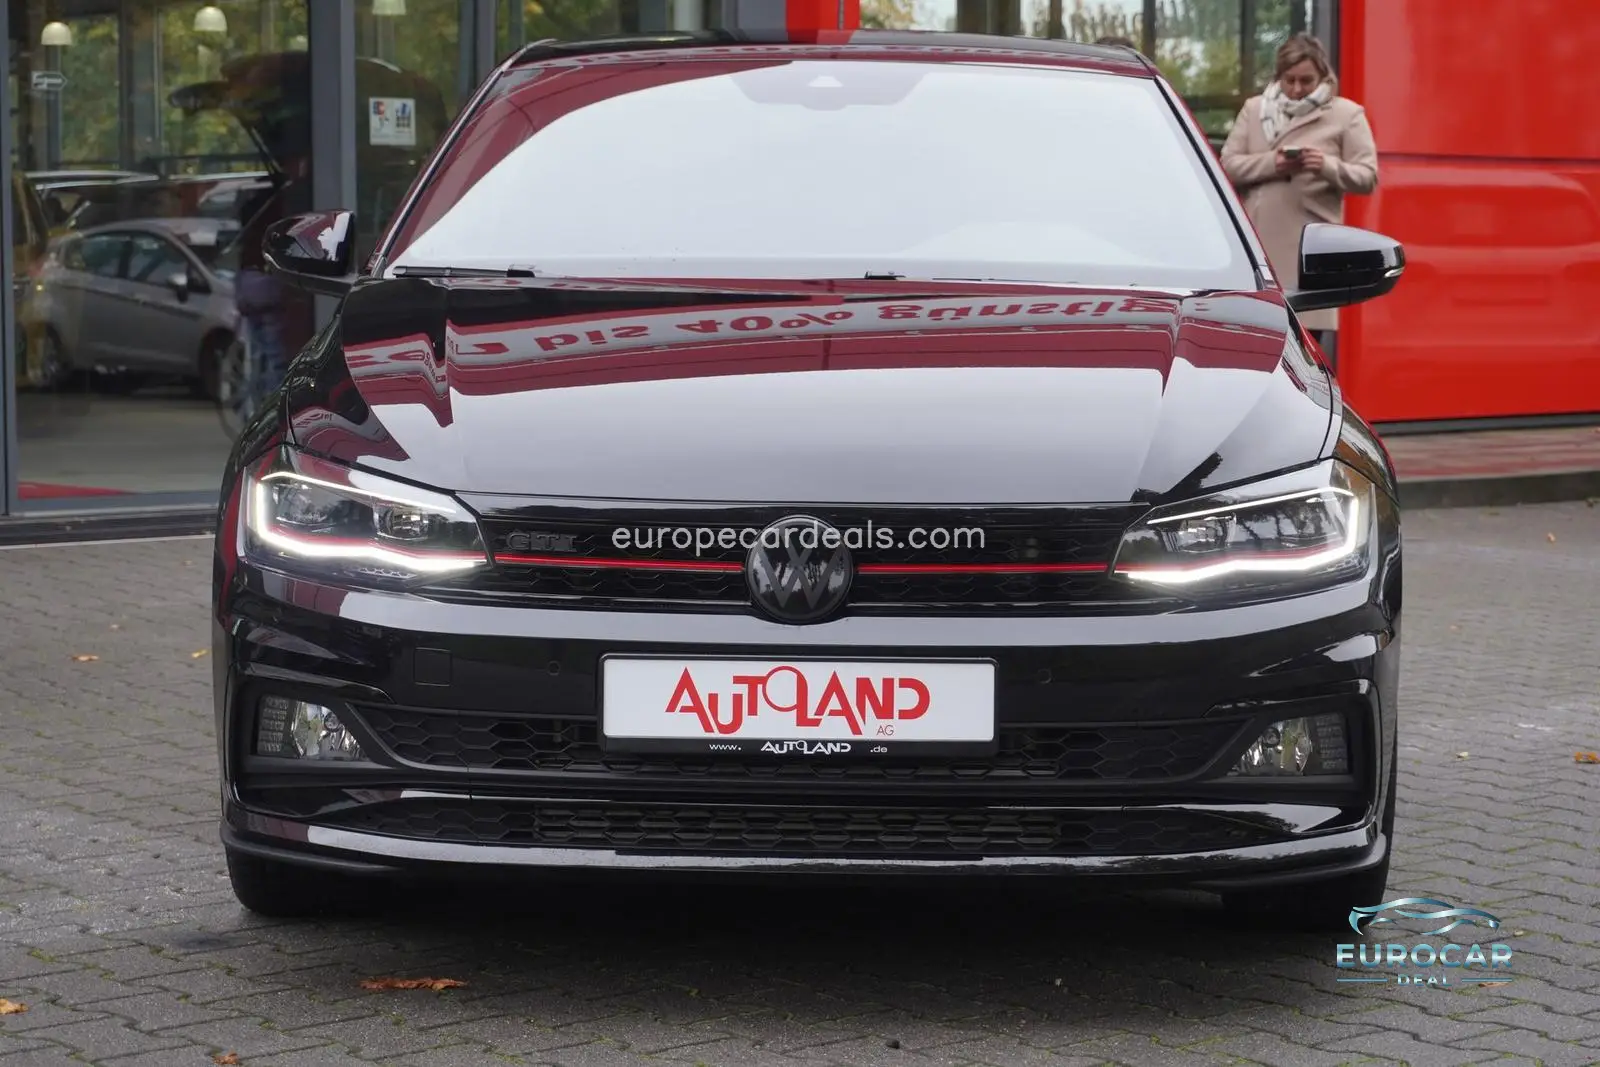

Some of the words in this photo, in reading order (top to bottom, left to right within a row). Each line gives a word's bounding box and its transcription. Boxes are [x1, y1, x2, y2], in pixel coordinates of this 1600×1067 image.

[506, 530, 579, 553] GTI
[664, 665, 931, 736] AUTOLAND
[876, 724, 895, 737] AG
[708, 743, 742, 751] www.
[760, 739, 852, 755] AUTOLAND
[869, 745, 888, 754] .de
